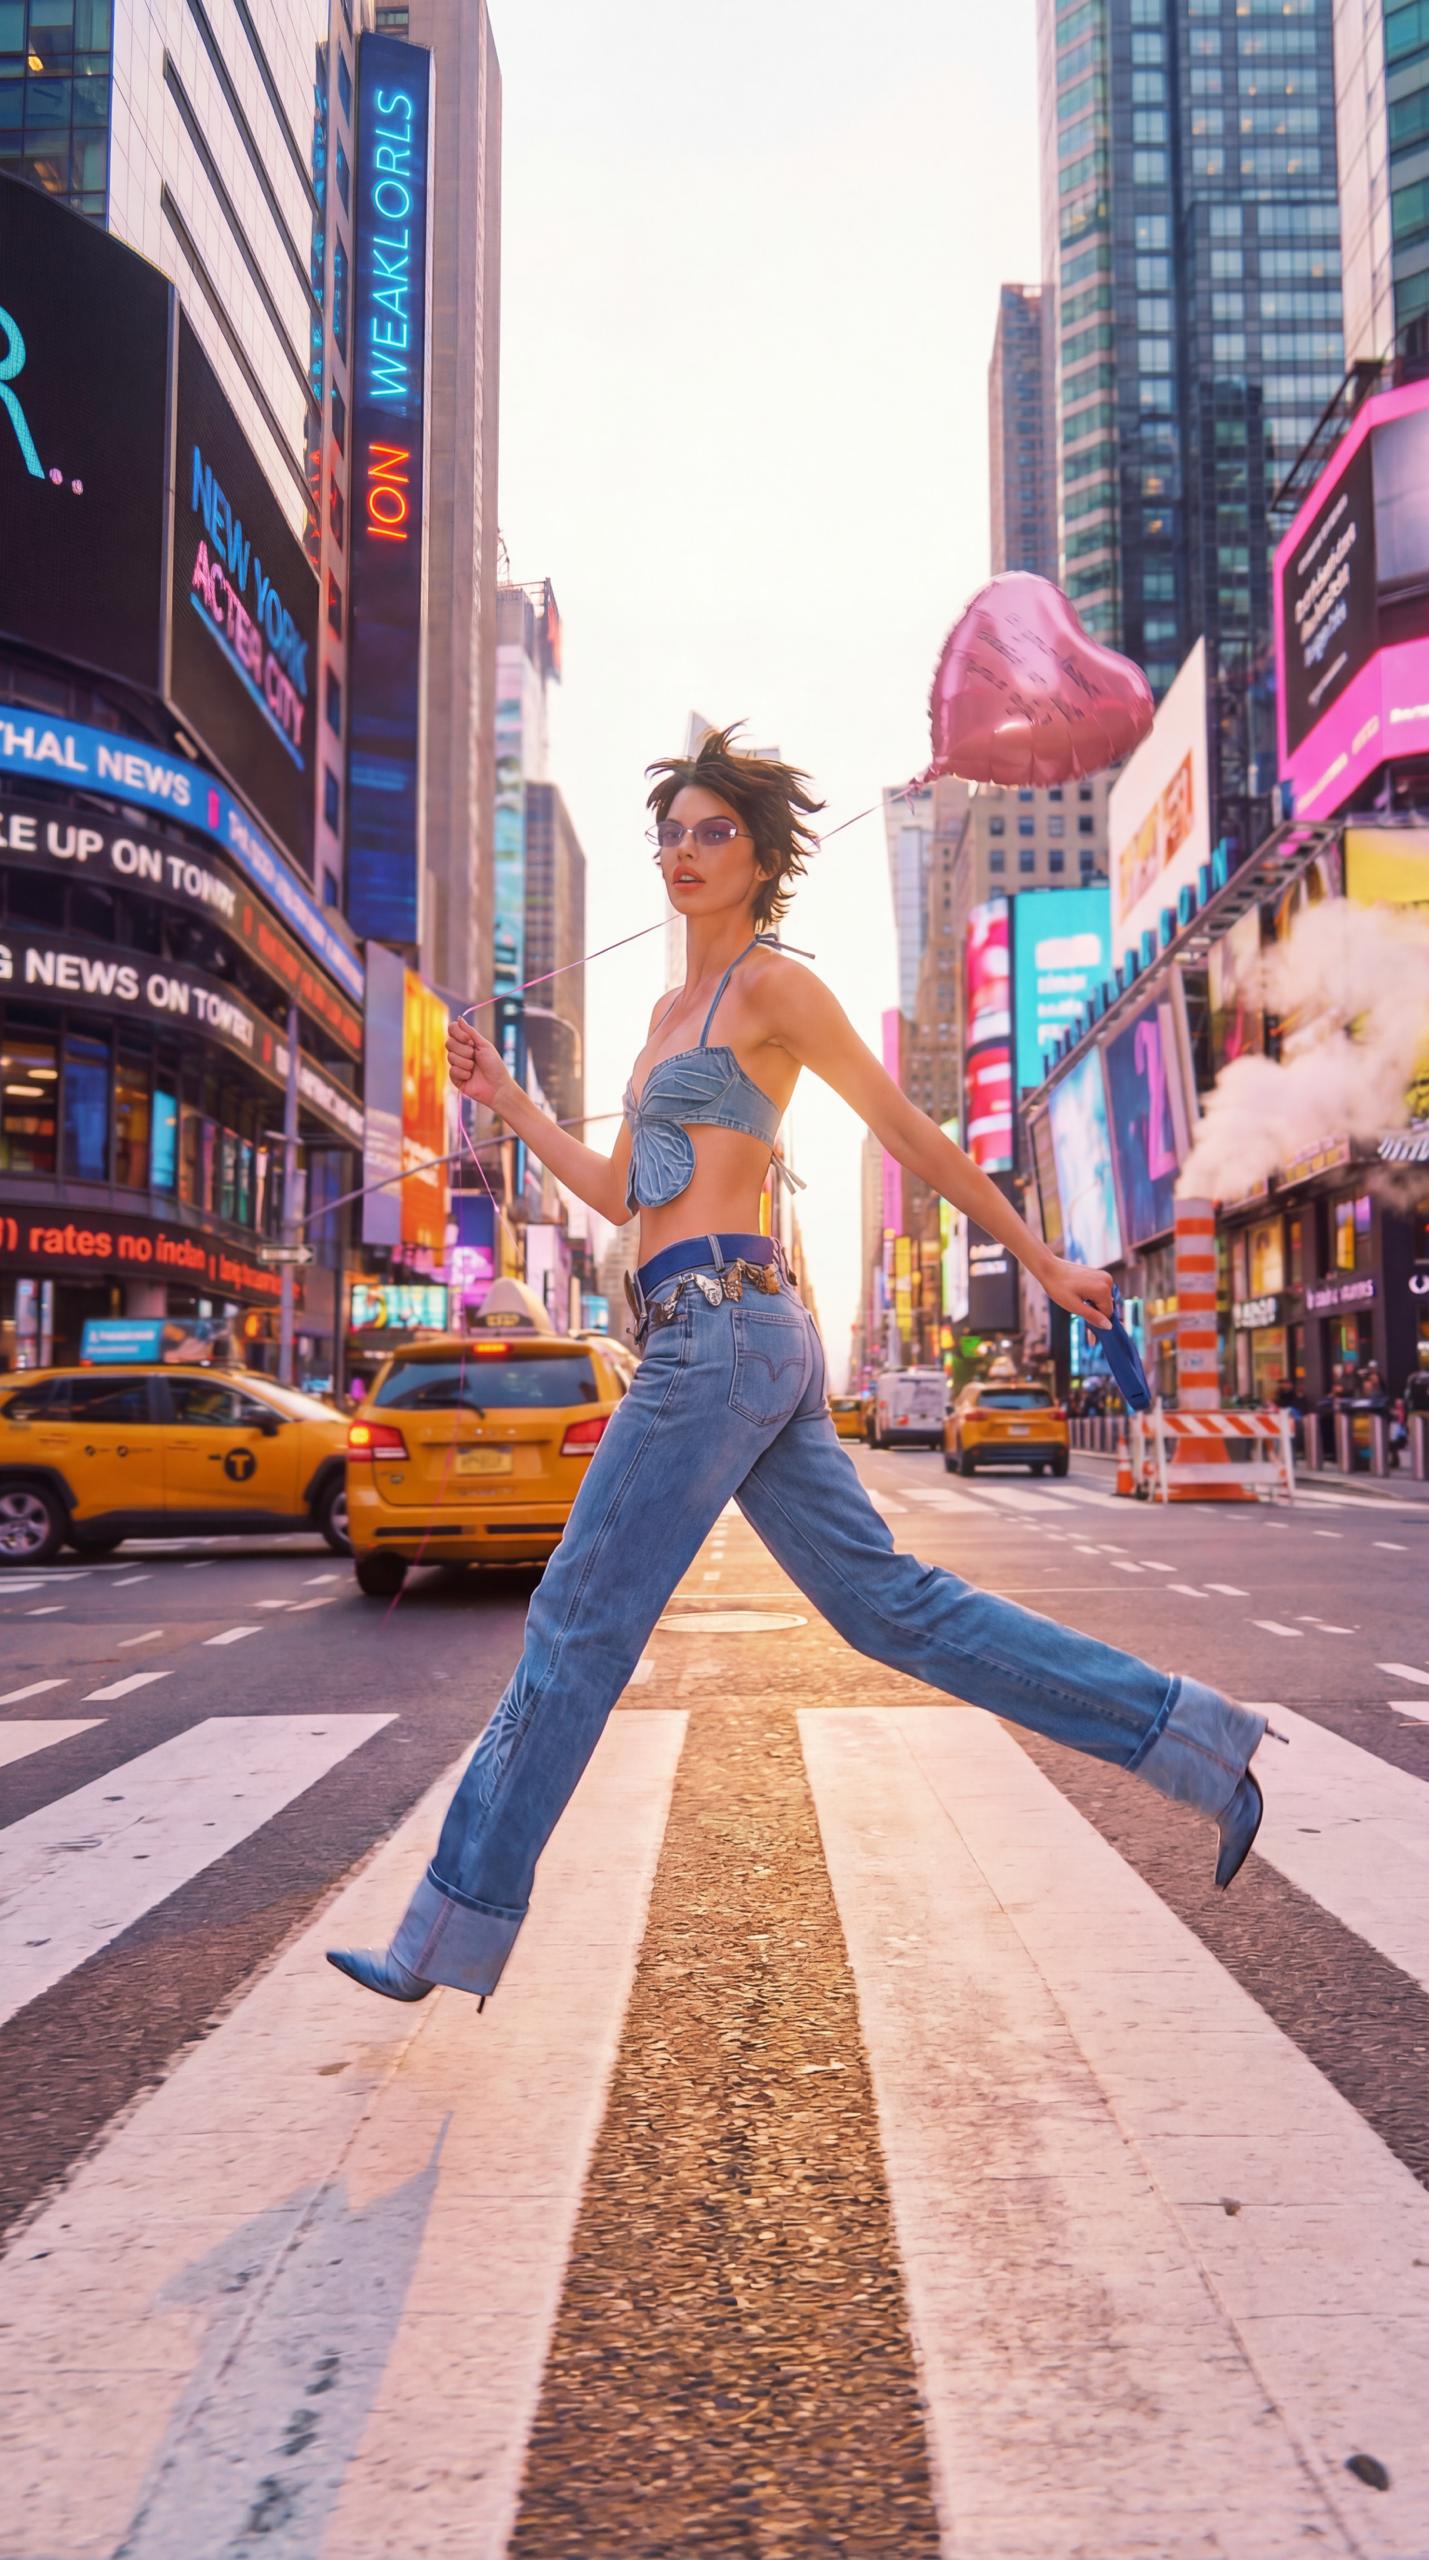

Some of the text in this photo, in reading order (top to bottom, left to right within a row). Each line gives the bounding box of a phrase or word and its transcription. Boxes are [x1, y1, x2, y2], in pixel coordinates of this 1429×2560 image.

[370, 90, 414, 397] WEAKLORLS
[367, 442, 410, 540] ION
[192, 445, 309, 696] NEW YORK
[192, 540, 262, 684] ACTER
[263, 652, 304, 747] CITY
[0, 720, 191, 806] HAL NEWS
[47, 821, 104, 862] UP
[111, 838, 162, 882] ON
[25, 948, 139, 1000] NEWS
[146, 974, 189, 1015] ON
[29, 1224, 111, 1258] rates
[118, 1234, 152, 1262] no
[230, 1456, 250, 1478] T
